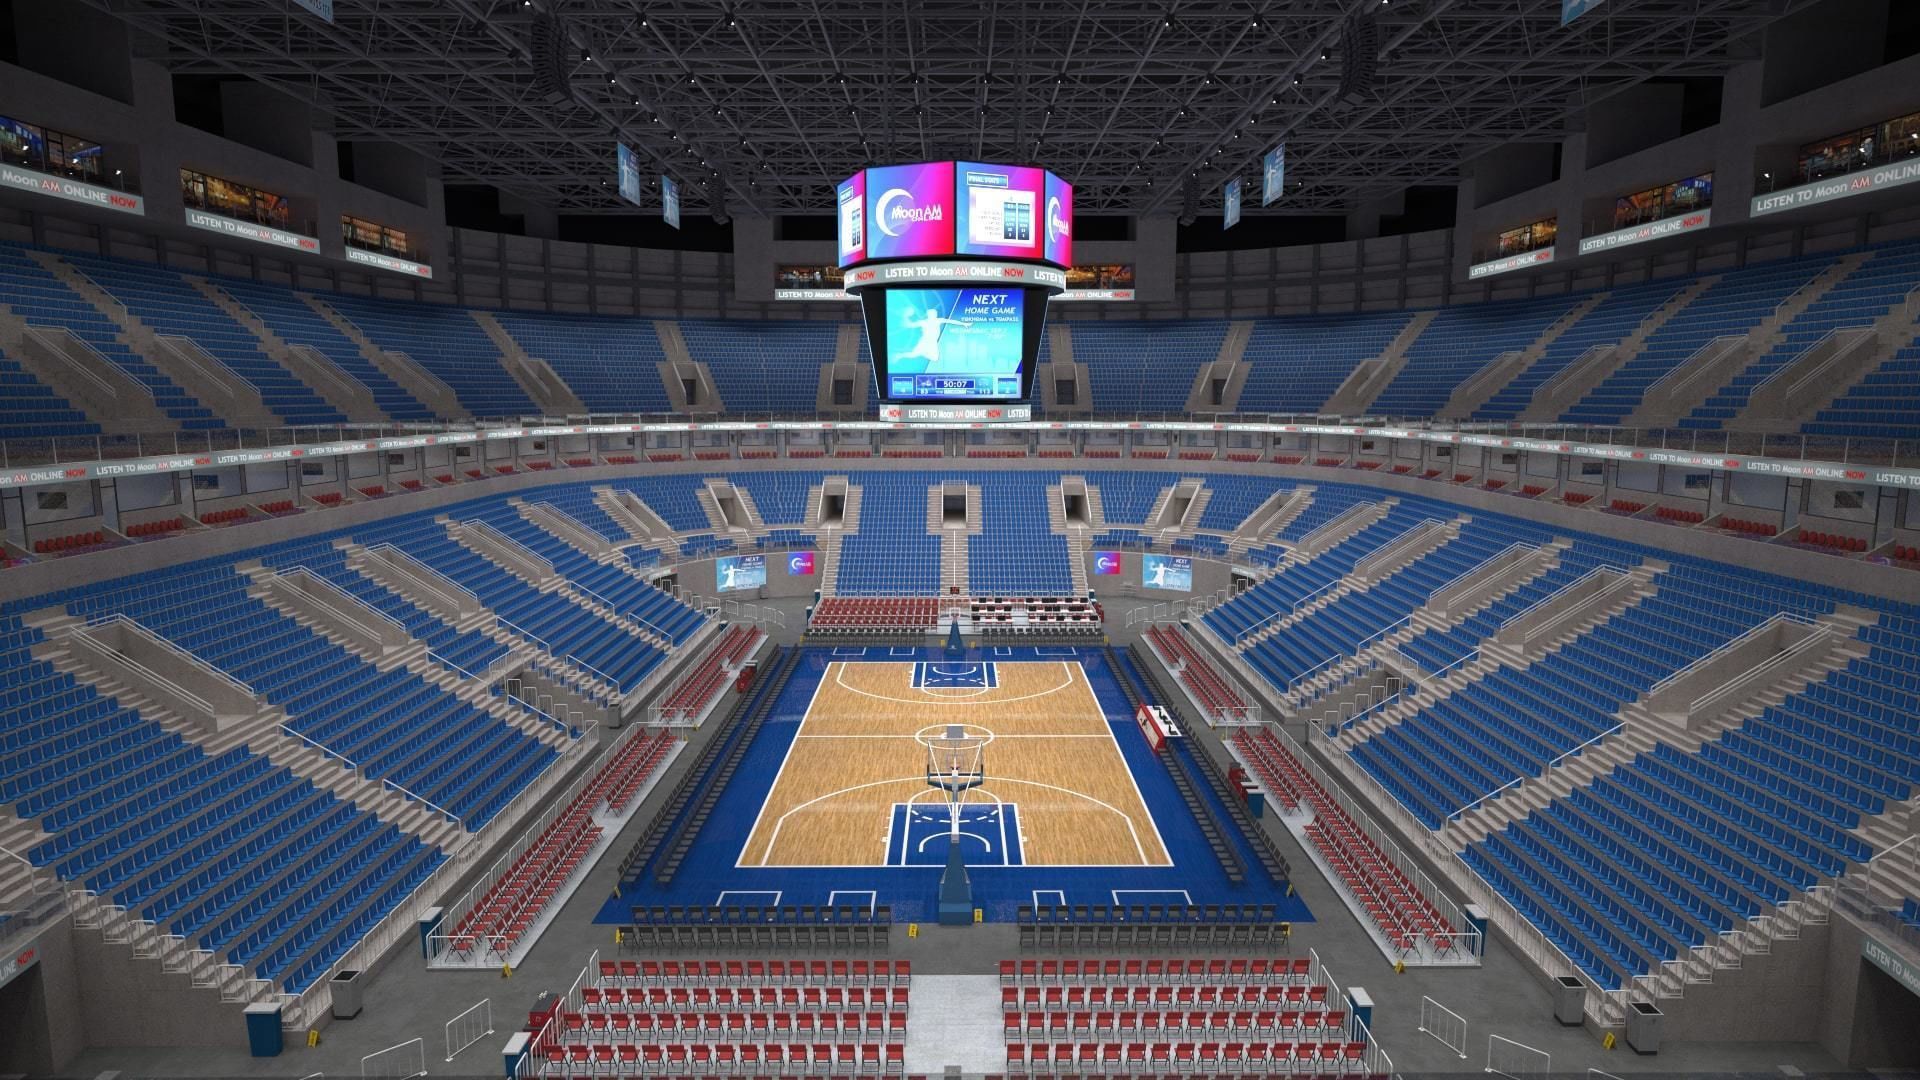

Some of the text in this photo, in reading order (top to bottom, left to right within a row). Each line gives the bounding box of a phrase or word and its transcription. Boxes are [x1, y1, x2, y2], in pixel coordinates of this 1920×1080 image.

[2, 170, 137, 209] Moon AM ONLINE NOW
[1757, 163, 1920, 211] LISTEN TO Moon AM ONLIN
[891, 204, 942, 220] Moon AM
[192, 214, 317, 249] LISTEN TO Moon AM ONLINE NOW
[1582, 215, 1705, 251] LISTEN TO Moon AM ONLINE NOW
[349, 251, 369, 262] LISTEN
[369, 255, 376, 263] TO
[857, 271, 876, 280] NOW
[885, 266, 1024, 278] LISTEN TO Moon AM ONLINE NOW
[1471, 266, 1487, 276] LISTEN
[972, 294, 1008, 305] NEXT
[943, 380, 968, 388] 50:07
[908, 409, 928, 418] LISTEN
[929, 409, 937, 418] TO
[938, 409, 954, 418] Moon
[965, 409, 986, 418] ONLINE
[97, 456, 211, 475] LISTEN TO Moon AM ONLINE NOW
[218, 455, 238, 464] LISTEN
[239, 454, 246, 462] TO
[1650, 453, 1668, 461] LISTEN
[1702, 457, 1723, 466] ONLINE
[14, 473, 28, 483] AM
[31, 470, 64, 482] ONLINE
[65, 467, 86, 479] NOW
[1747, 462, 1866, 479] LISTEN TO Moon AM ONLINE NOW
[1876, 473, 1907, 484] LISTEN
[17, 946, 35, 966] NOW
[1866, 941, 1890, 968] LISTEN
[1891, 959, 1902, 975] TO
